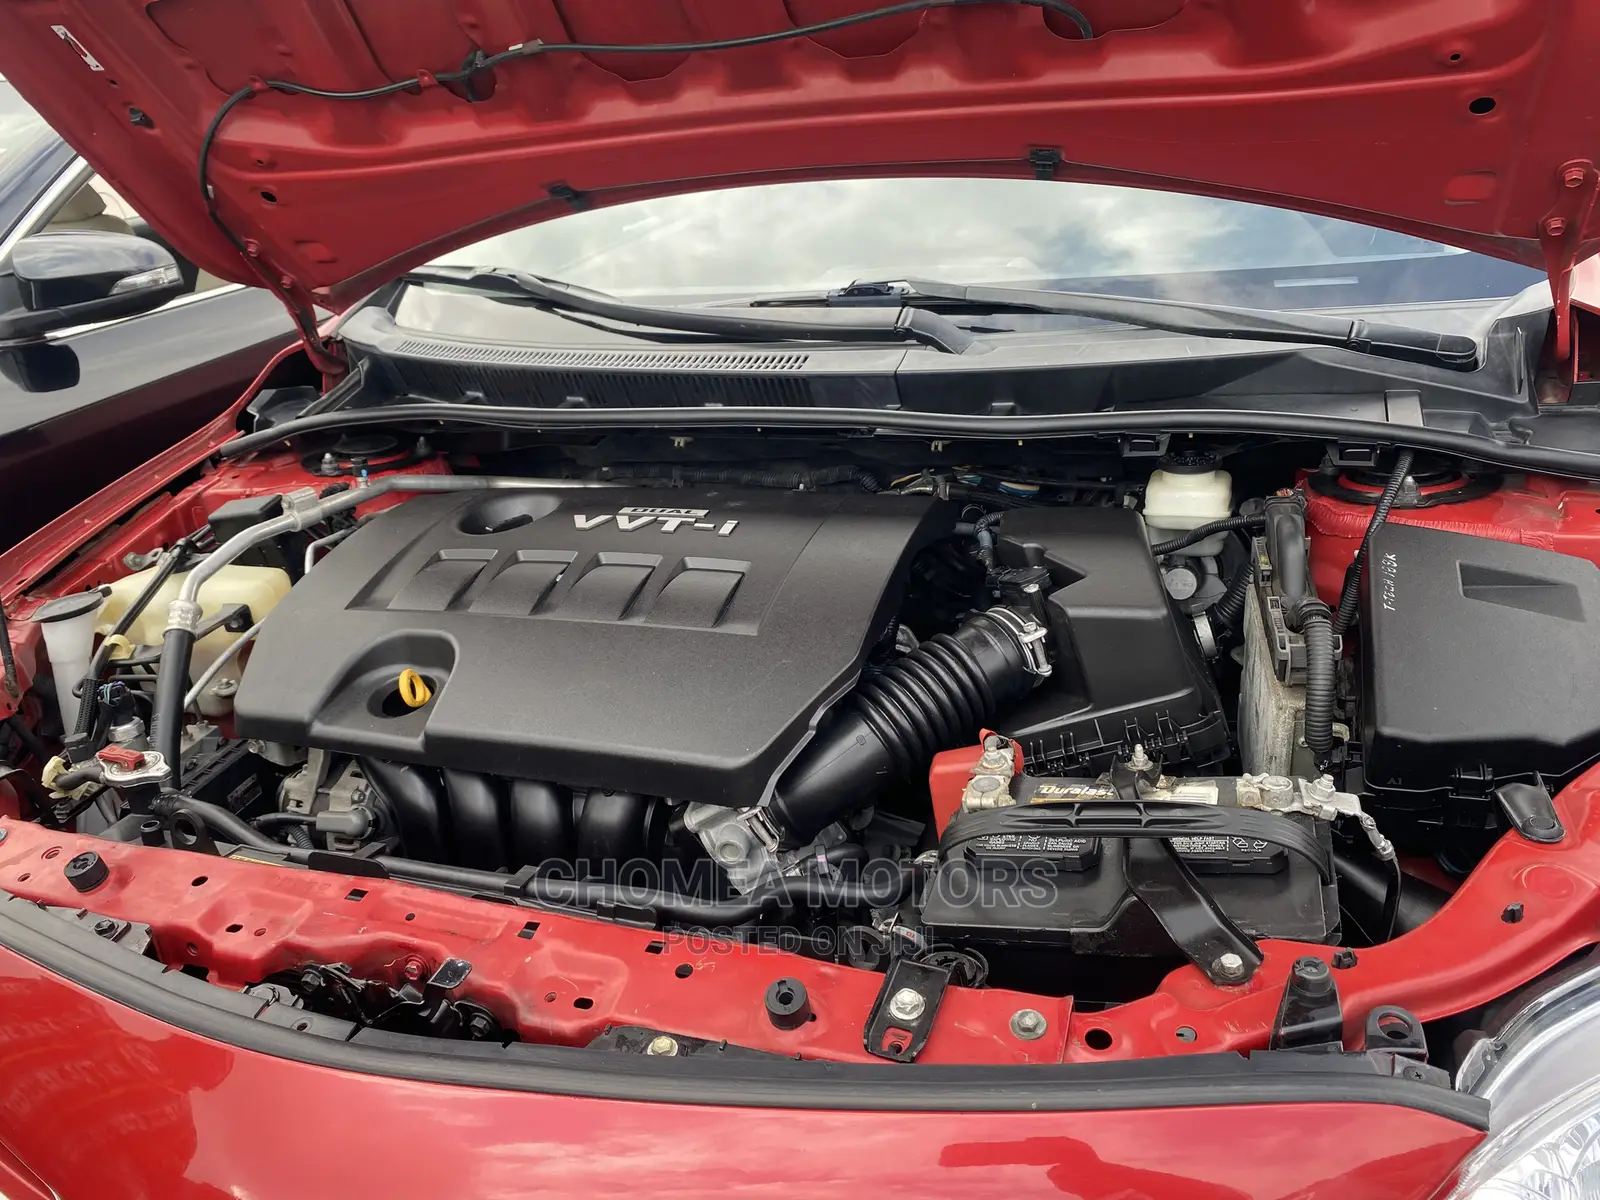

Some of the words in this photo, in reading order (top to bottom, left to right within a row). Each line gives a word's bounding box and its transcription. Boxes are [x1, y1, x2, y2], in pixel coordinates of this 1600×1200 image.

[630, 507, 699, 515] DUAL
[1382, 578, 1396, 611] T-TECH
[1039, 784, 1114, 796] Duralast
